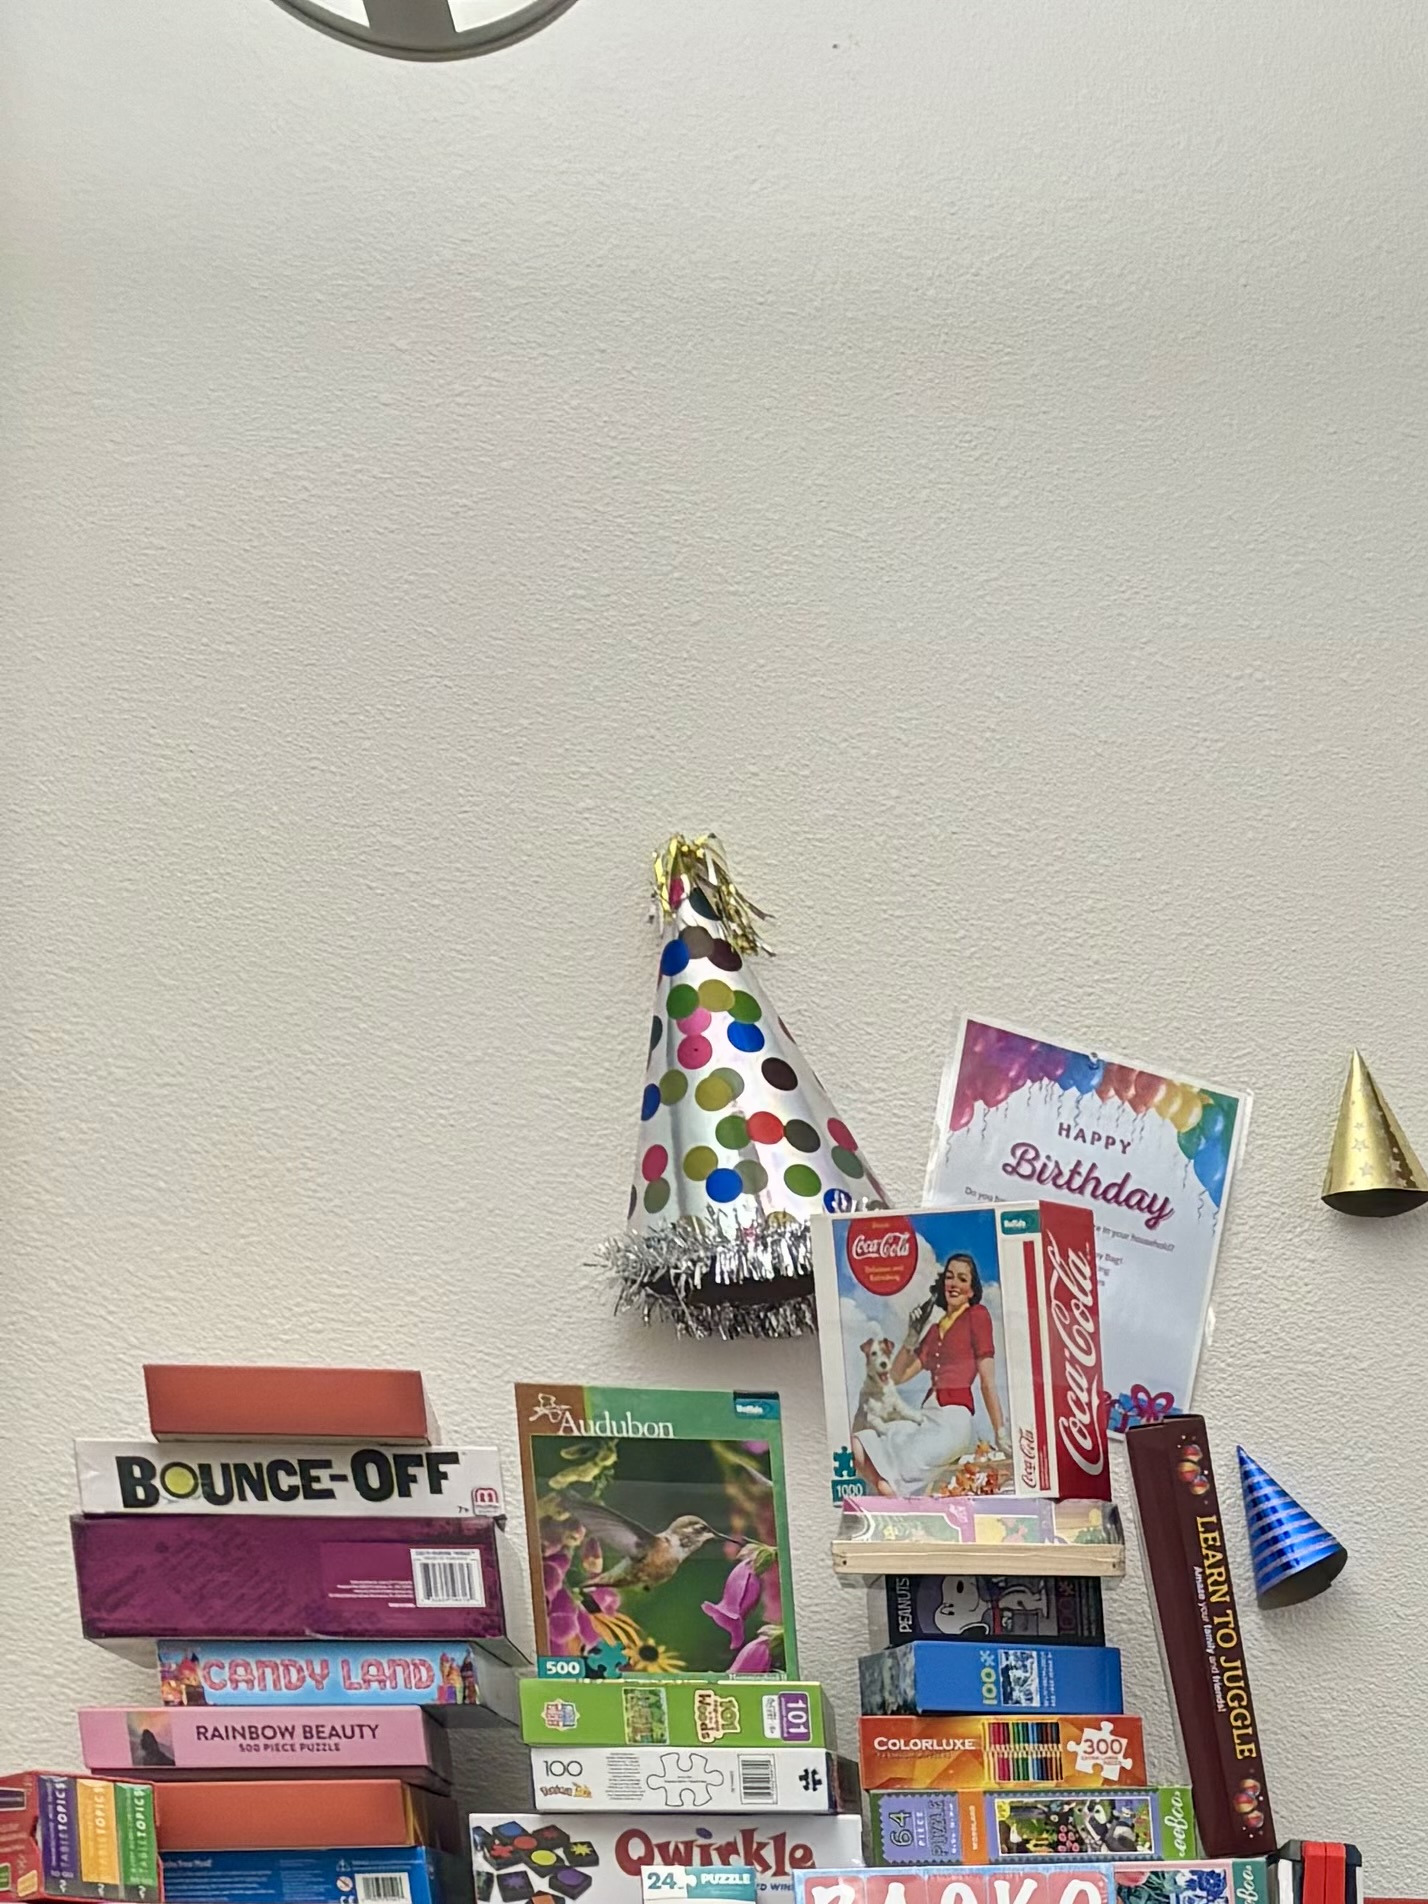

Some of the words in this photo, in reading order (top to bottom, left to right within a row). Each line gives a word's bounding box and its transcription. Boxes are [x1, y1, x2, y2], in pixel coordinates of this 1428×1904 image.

[1057, 1121, 1132, 1155] HAPPY
[1001, 1141, 1175, 1230] Birthday
[557, 1411, 675, 1440] Audubon
[115, 1448, 460, 1509] BOUNCE-OFF
[835, 1482, 865, 1499] 1000
[1196, 1516, 1230, 1604] LEARN
[899, 1577, 912, 1634] PEANUTS
[1214, 1610, 1238, 1649] TO
[201, 1658, 330, 1692] CANDY
[341, 1657, 437, 1691] LAND
[546, 1662, 580, 1676] 500
[980, 1667, 997, 1706] 100
[698, 1693, 713, 1741] Woods
[786, 1698, 809, 1736] 101
[1218, 1656, 1259, 1760] JUGGLE
[196, 1725, 296, 1741] RAINBOW
[302, 1724, 380, 1741] BEAUTY
[238, 1743, 261, 1753] 500
[264, 1743, 296, 1753] PIECE
[299, 1742, 341, 1753] PUZZLE
[1081, 1737, 1123, 1757] 300
[543, 1760, 583, 1777] 100
[890, 1810, 912, 1848] 64
[614, 1826, 817, 1878] Qwirkle
[648, 1872, 676, 1889] 24
[701, 1873, 751, 1886] PUZZLE
